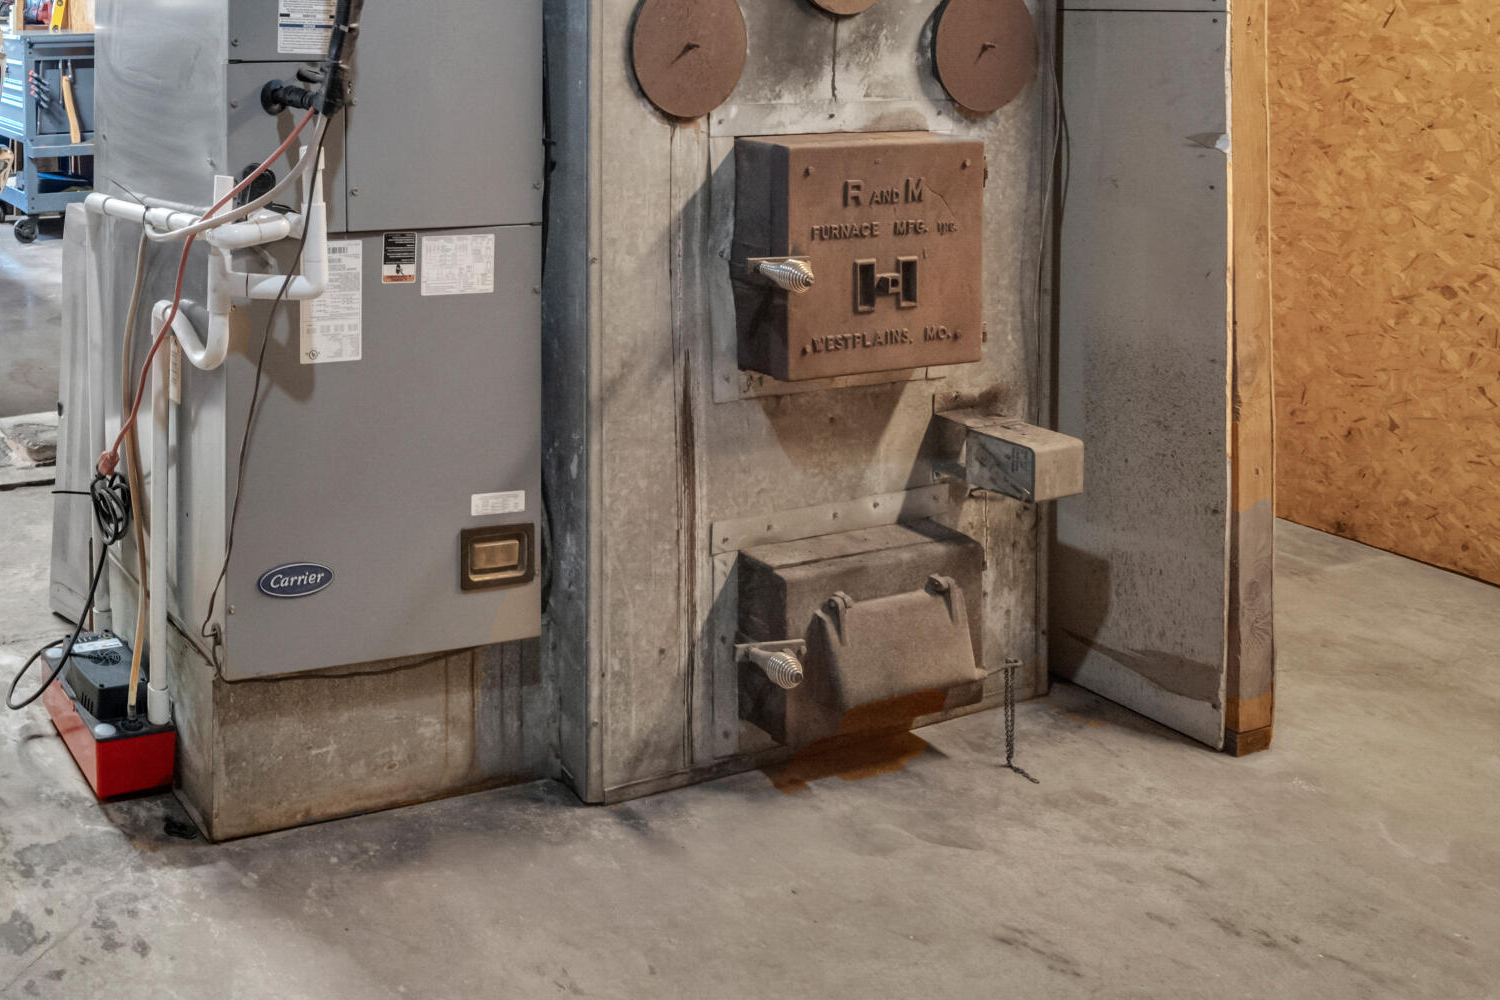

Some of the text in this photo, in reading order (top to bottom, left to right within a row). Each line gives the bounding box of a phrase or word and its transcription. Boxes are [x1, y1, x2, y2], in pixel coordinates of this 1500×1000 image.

[843, 177, 925, 208] R AND M
[810, 221, 881, 242] FURNACE
[269, 570, 325, 590] Carrier
